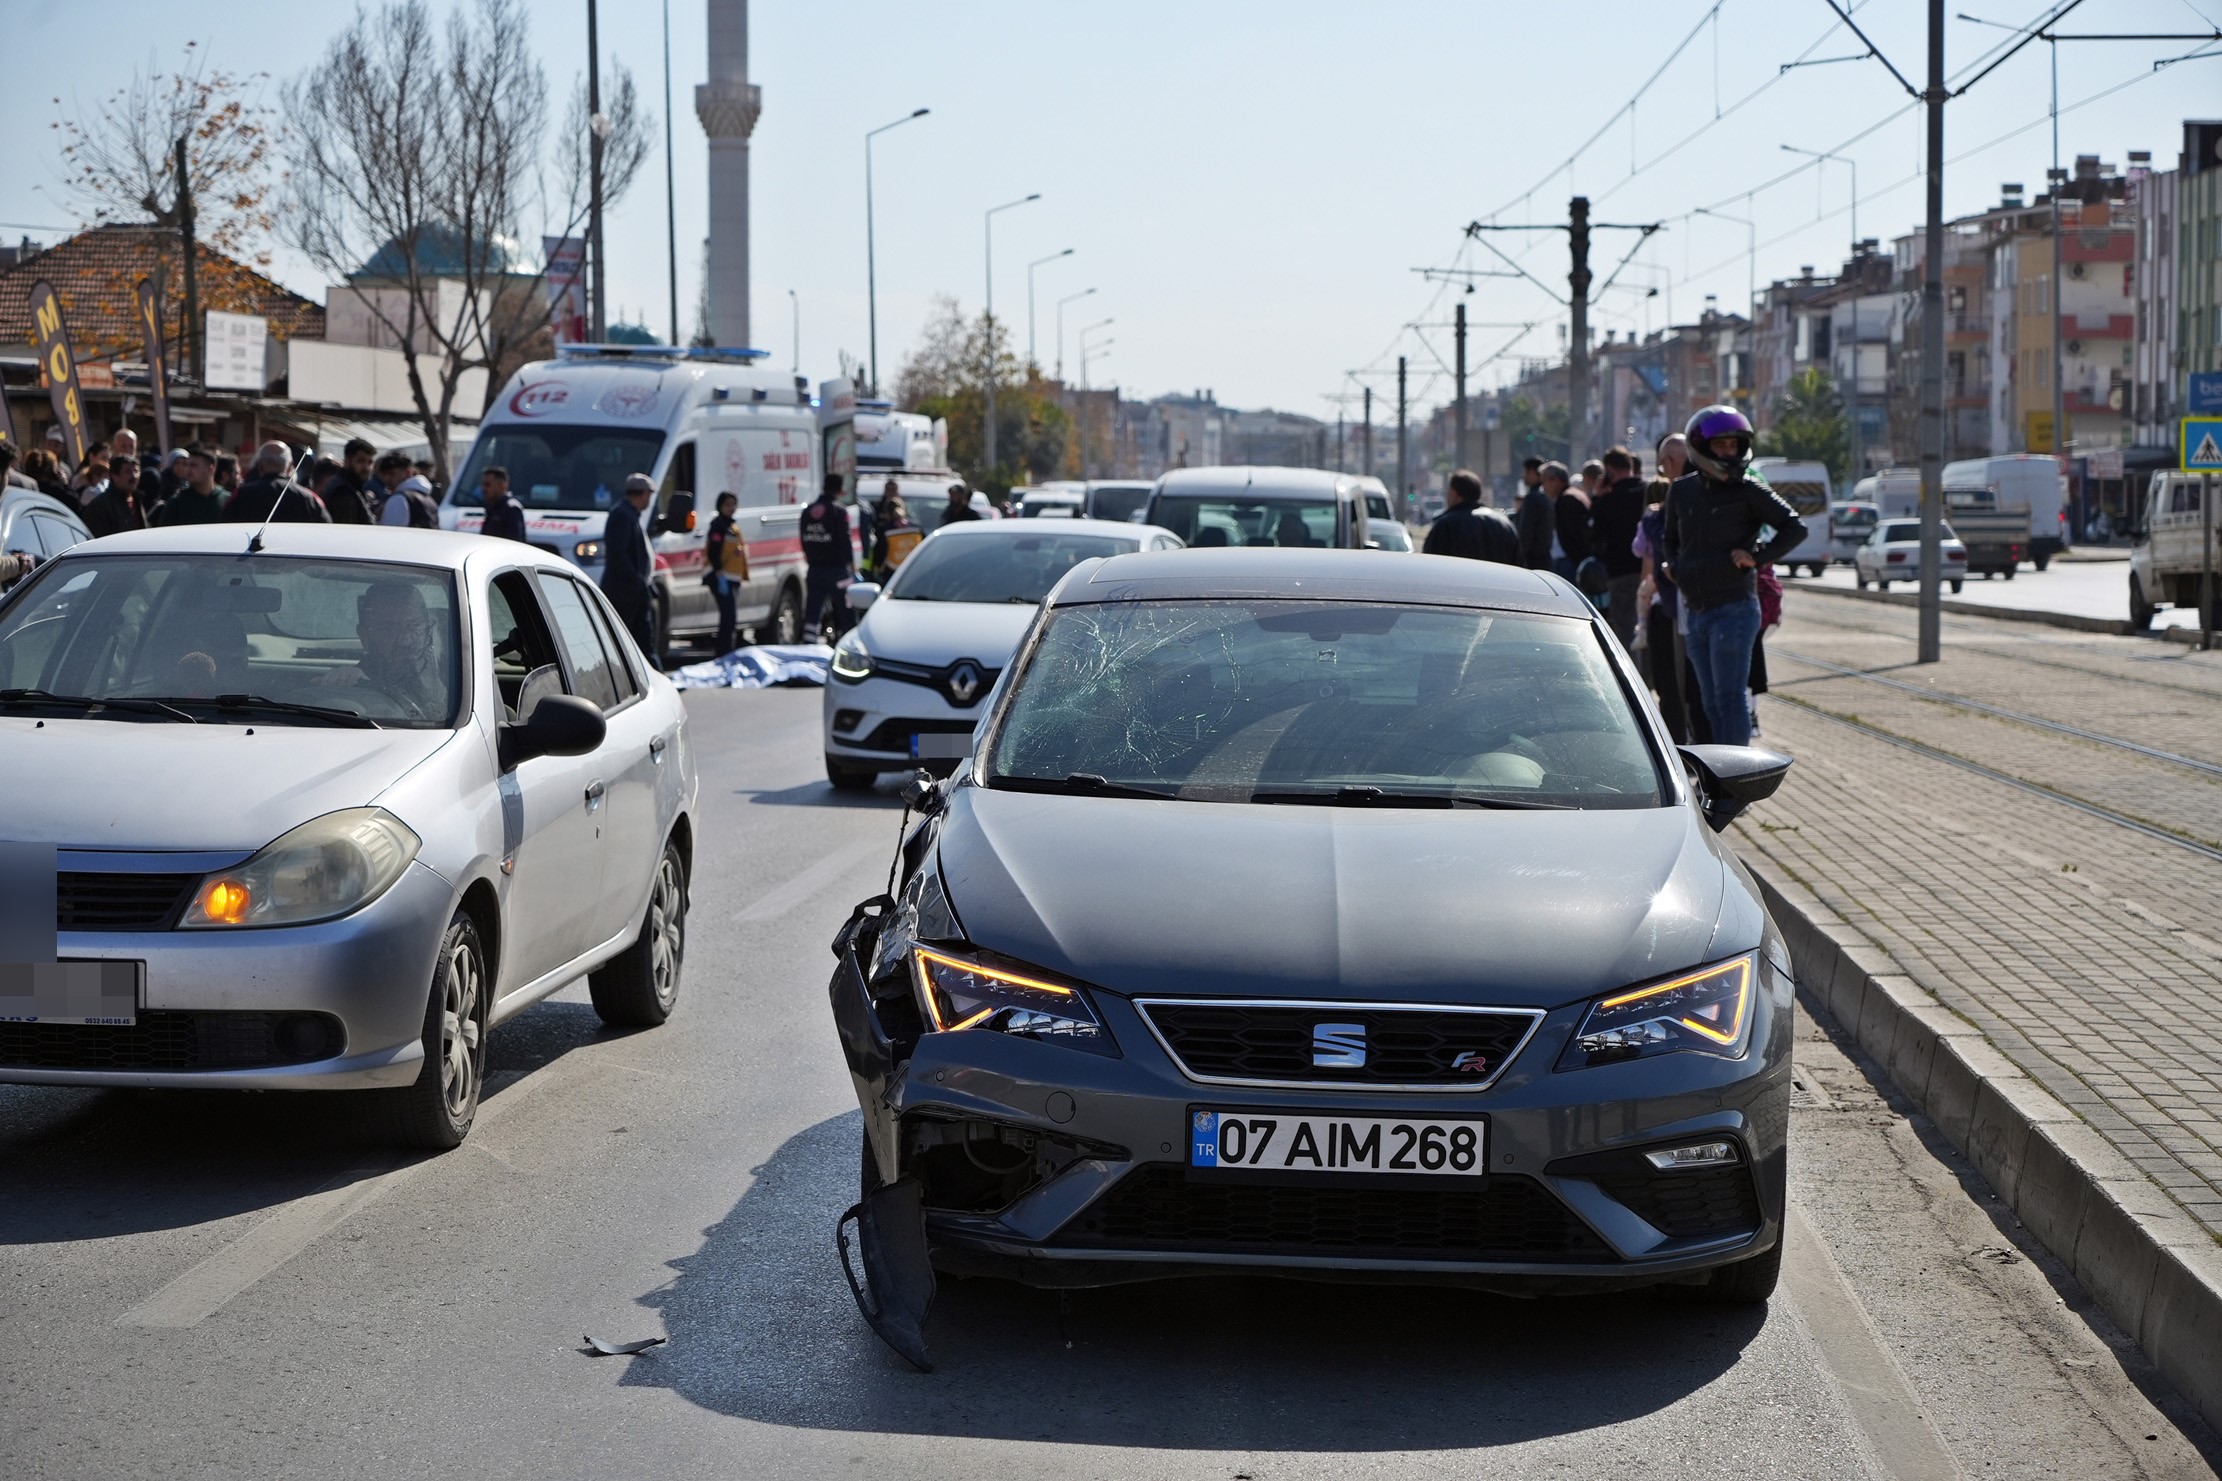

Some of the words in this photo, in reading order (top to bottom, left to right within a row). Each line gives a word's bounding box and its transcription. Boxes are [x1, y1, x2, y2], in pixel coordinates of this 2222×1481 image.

[525, 389, 564, 402] 112
[1196, 1143, 1214, 1157] TR
[1218, 1118, 1277, 1165] 07
[1284, 1122, 1381, 1169] AIM
[1389, 1124, 1477, 1171] 268
